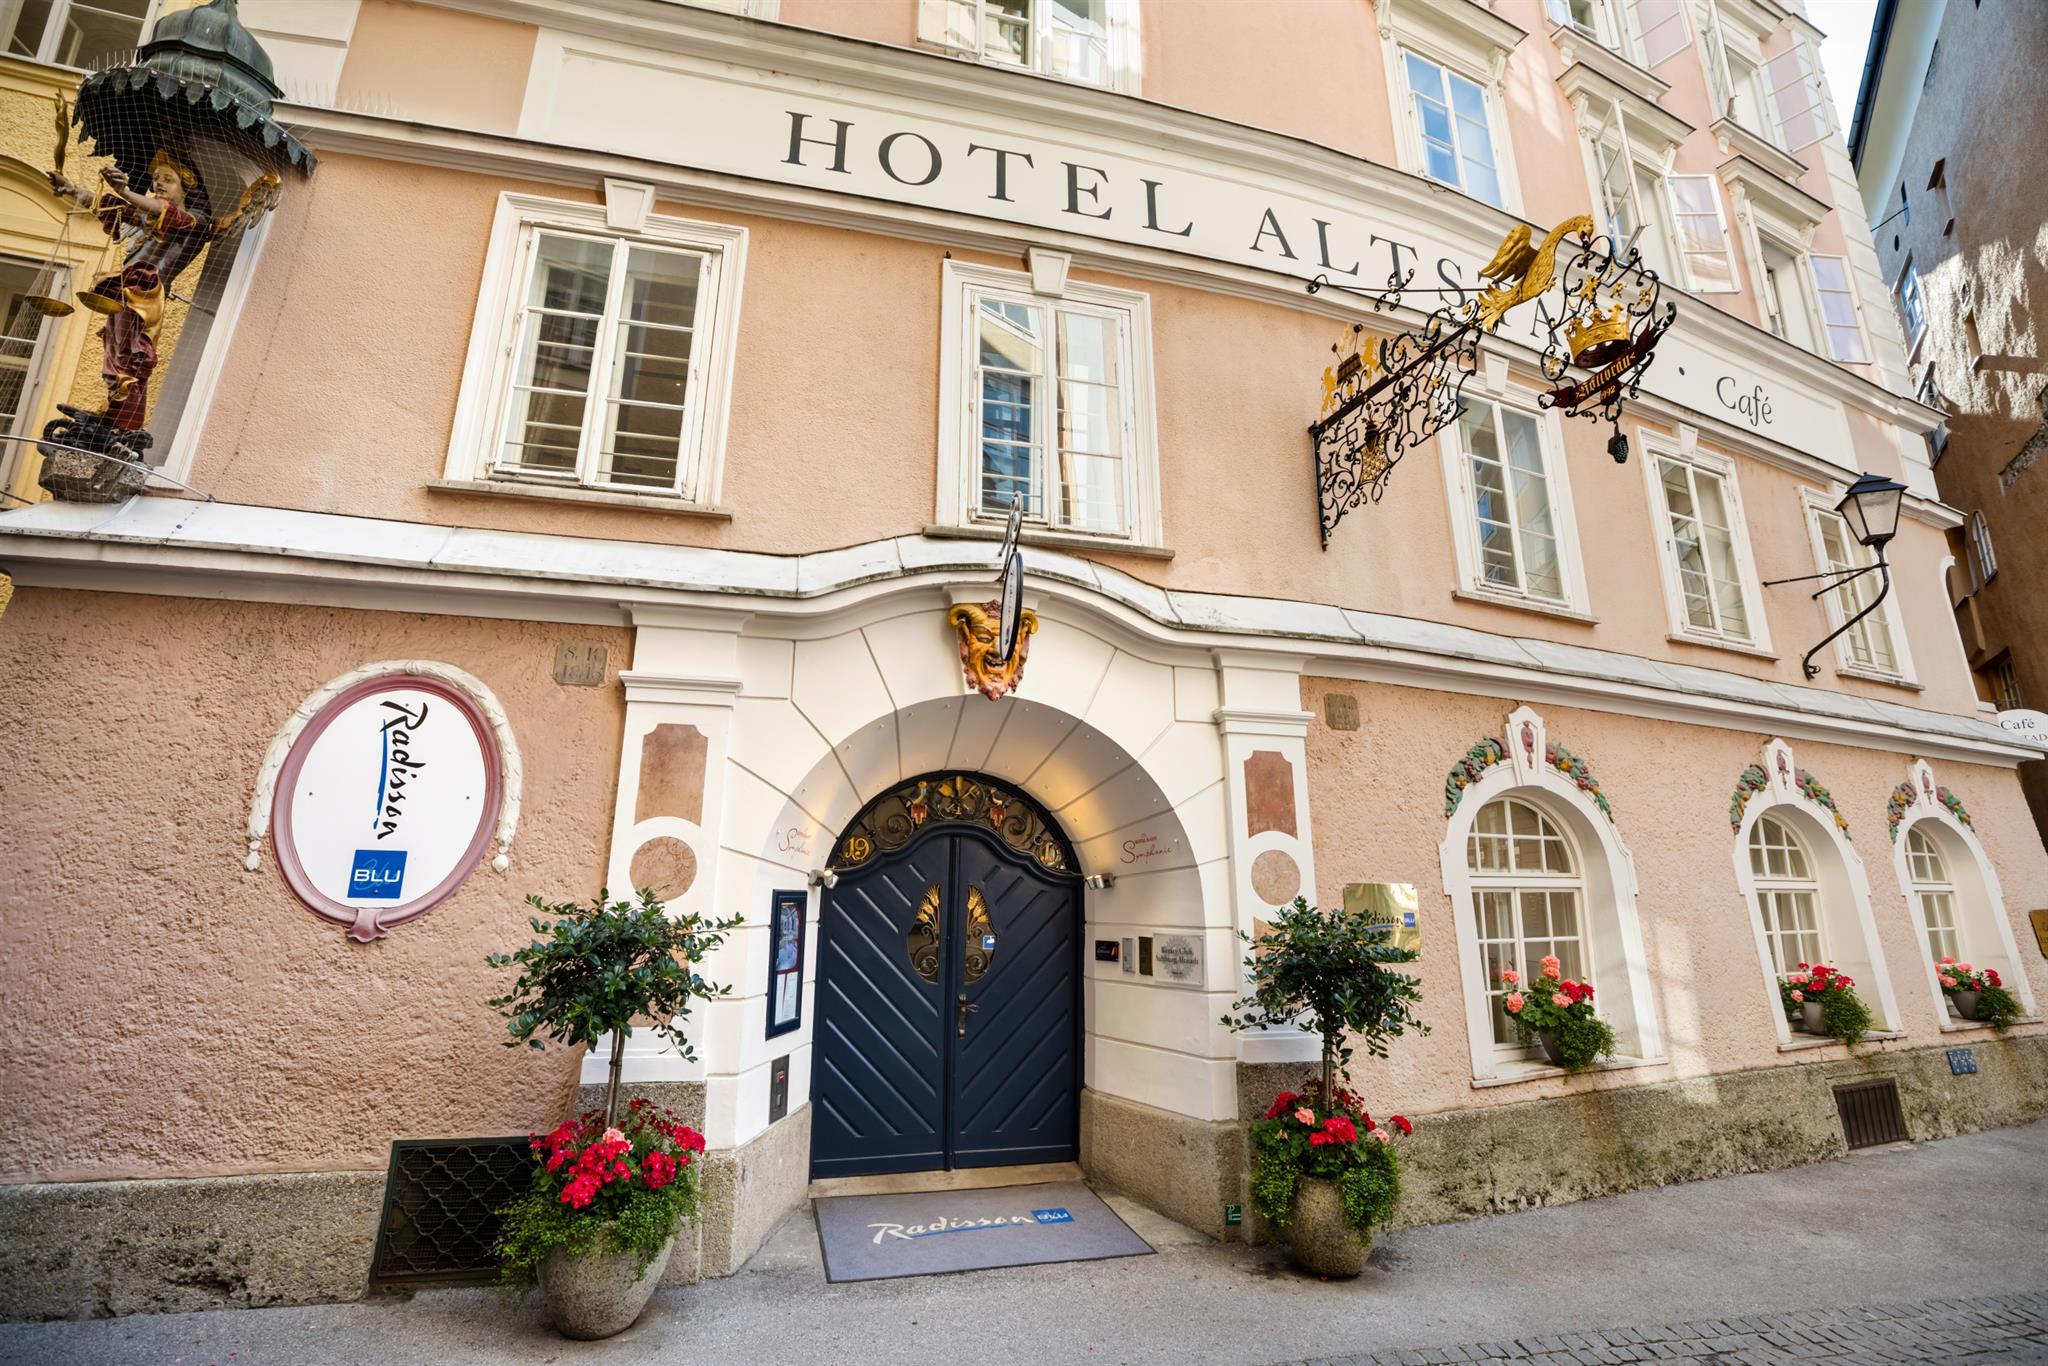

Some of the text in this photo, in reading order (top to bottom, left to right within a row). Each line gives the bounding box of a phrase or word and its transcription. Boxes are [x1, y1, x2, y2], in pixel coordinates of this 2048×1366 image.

[780, 110, 1774, 427] HOTEL ALTSA Café
[2000, 718, 2035, 731] Café
[377, 701, 428, 840] Radisson
[845, 837, 870, 860] 19
[354, 869, 400, 883] BLU
[867, 1216, 1034, 1244] Radisson
